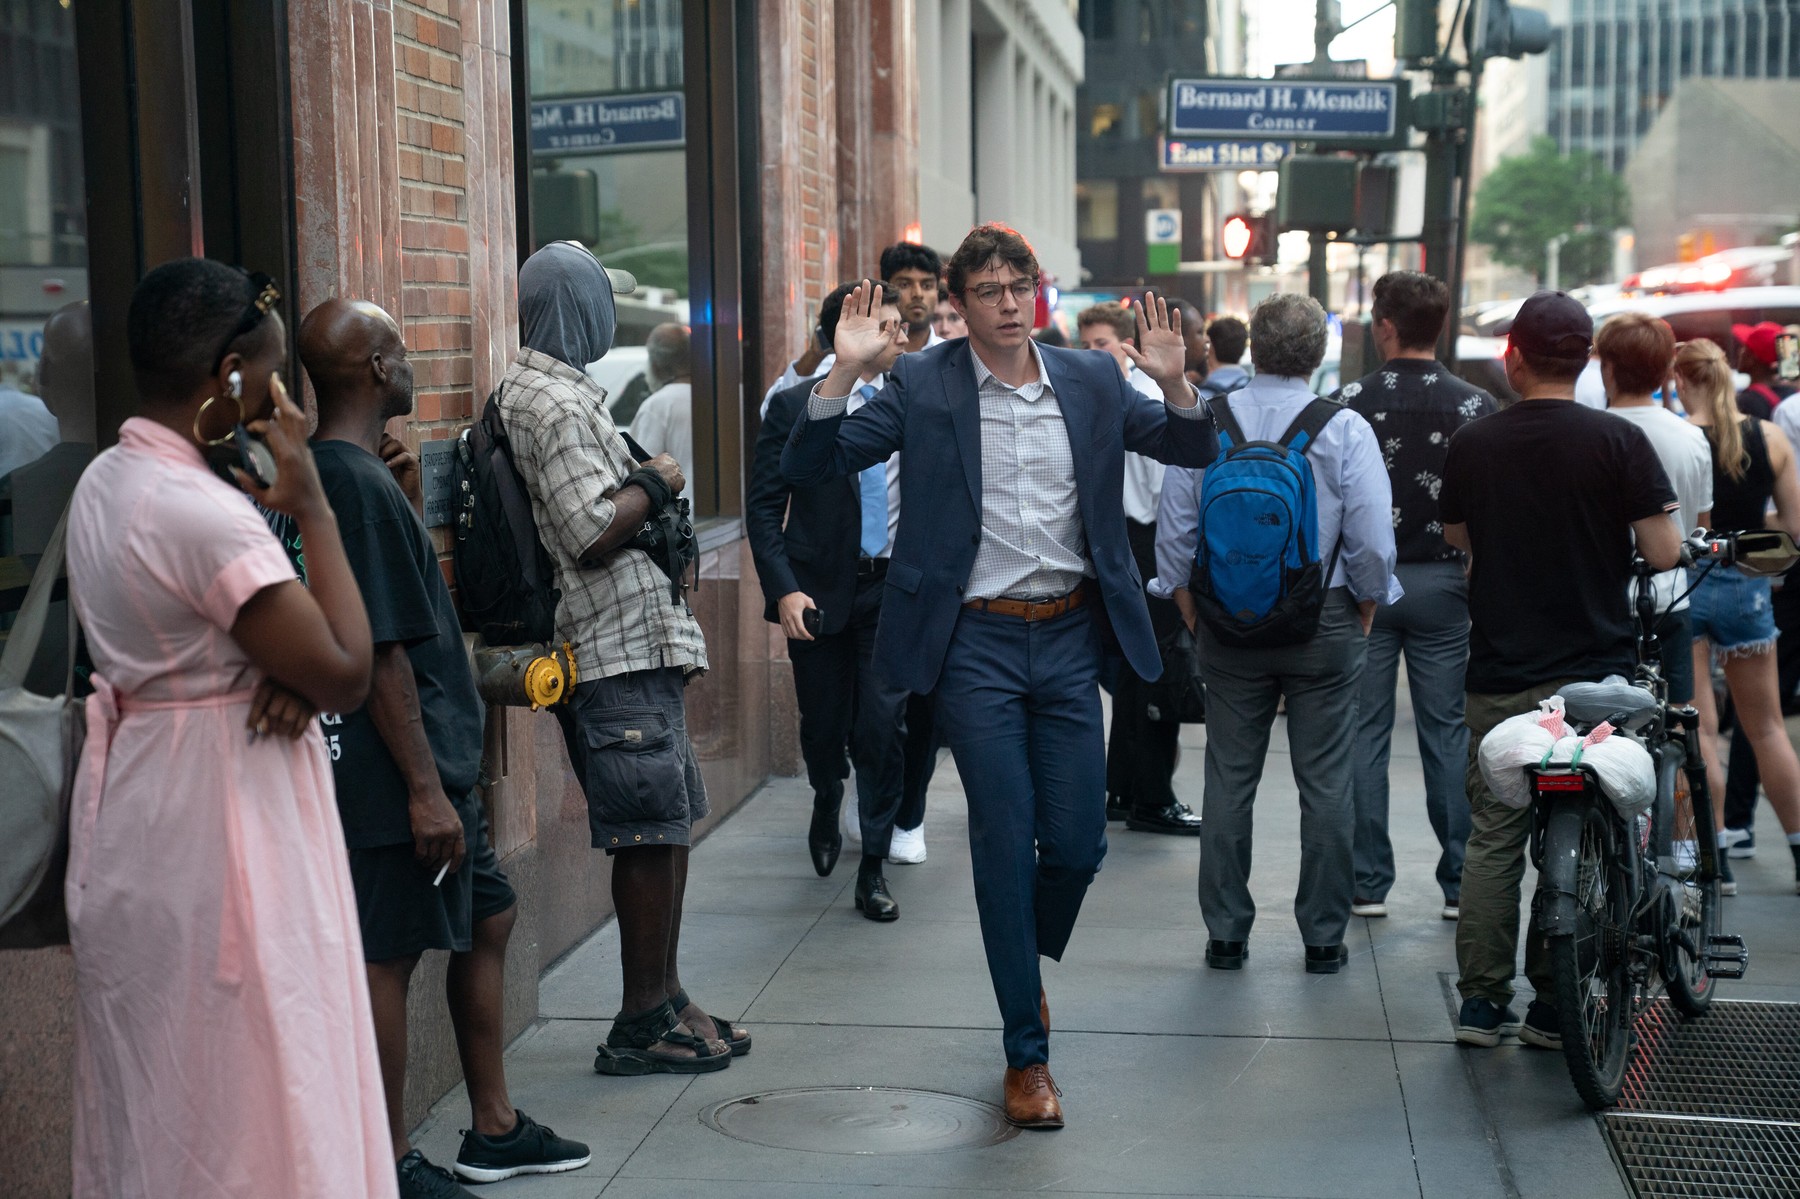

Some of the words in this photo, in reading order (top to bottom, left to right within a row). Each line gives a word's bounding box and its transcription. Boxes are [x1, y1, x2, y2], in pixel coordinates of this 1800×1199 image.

[1179, 85, 1266, 110] Bernard
[1270, 87, 1297, 110] H.
[1302, 86, 1387, 111] Mendik
[1247, 112, 1317, 130] Corner
[1171, 142, 1214, 163] East
[1218, 142, 1257, 163] 51st
